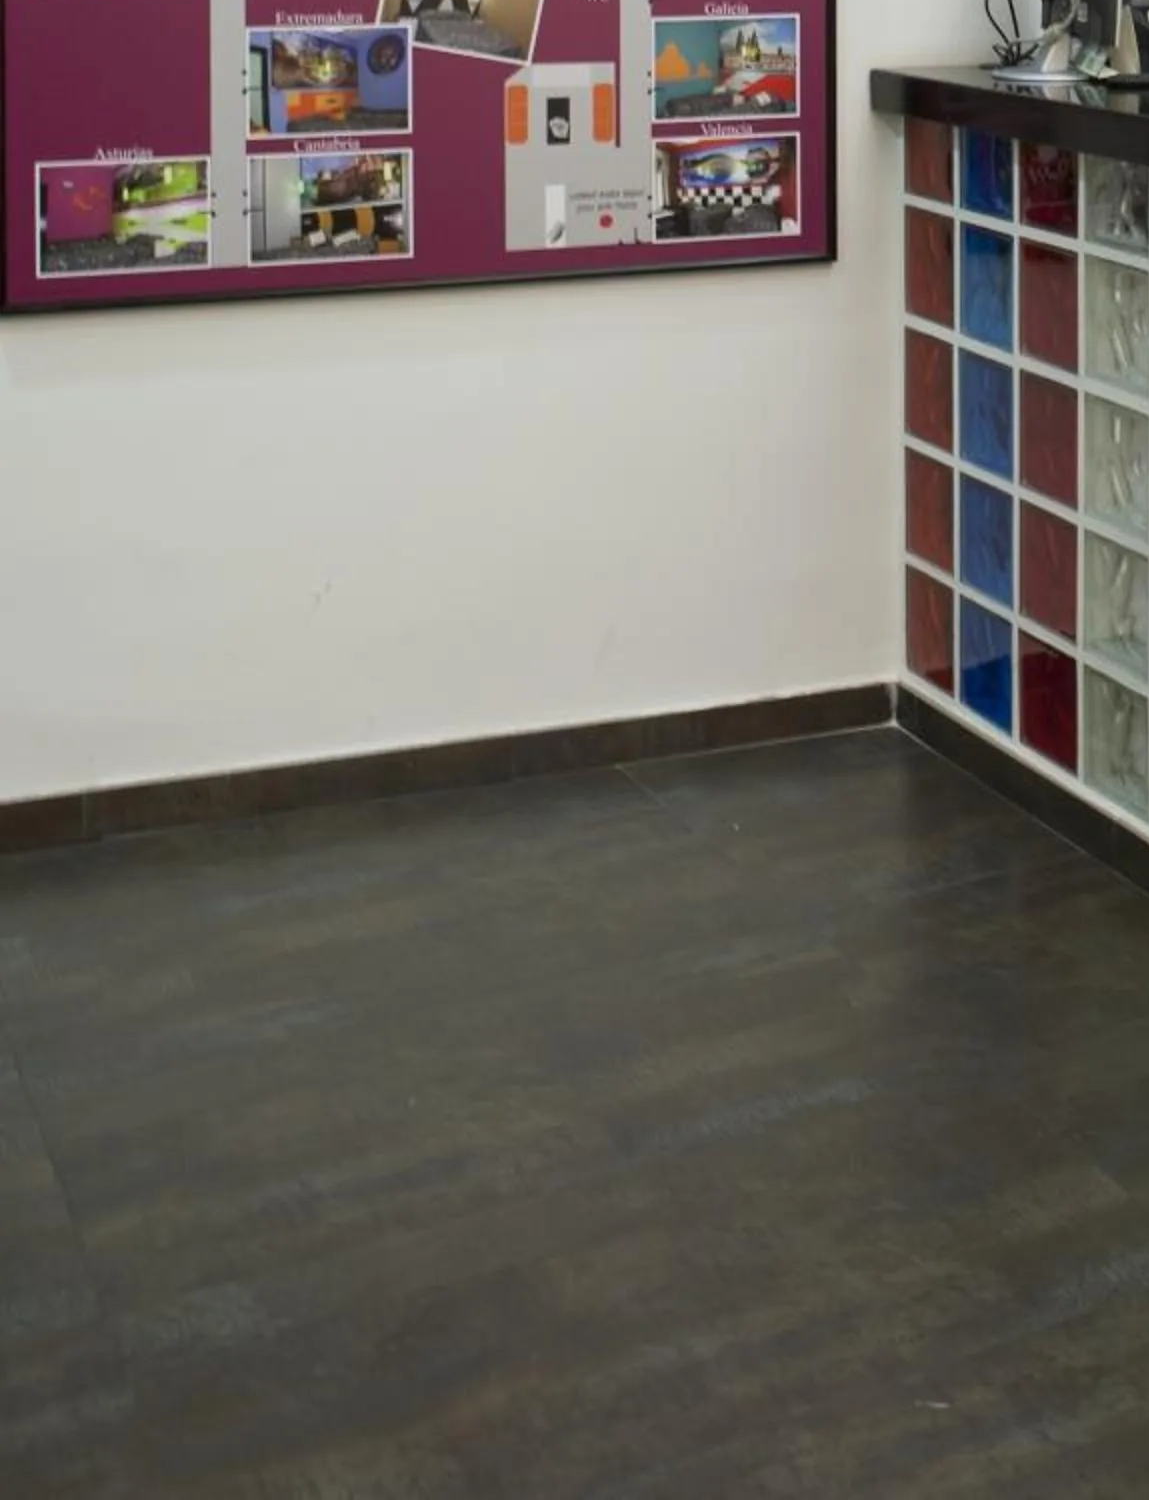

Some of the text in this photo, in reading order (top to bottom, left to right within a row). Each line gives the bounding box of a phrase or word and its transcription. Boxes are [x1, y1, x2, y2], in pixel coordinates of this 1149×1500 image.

[704, 2, 750, 16] Galicia
[275, 10, 363, 26] Extremadura
[701, 122, 753, 137] Valencia
[293, 134, 361, 153] Cantabria
[95, 145, 154, 163] Asturias
